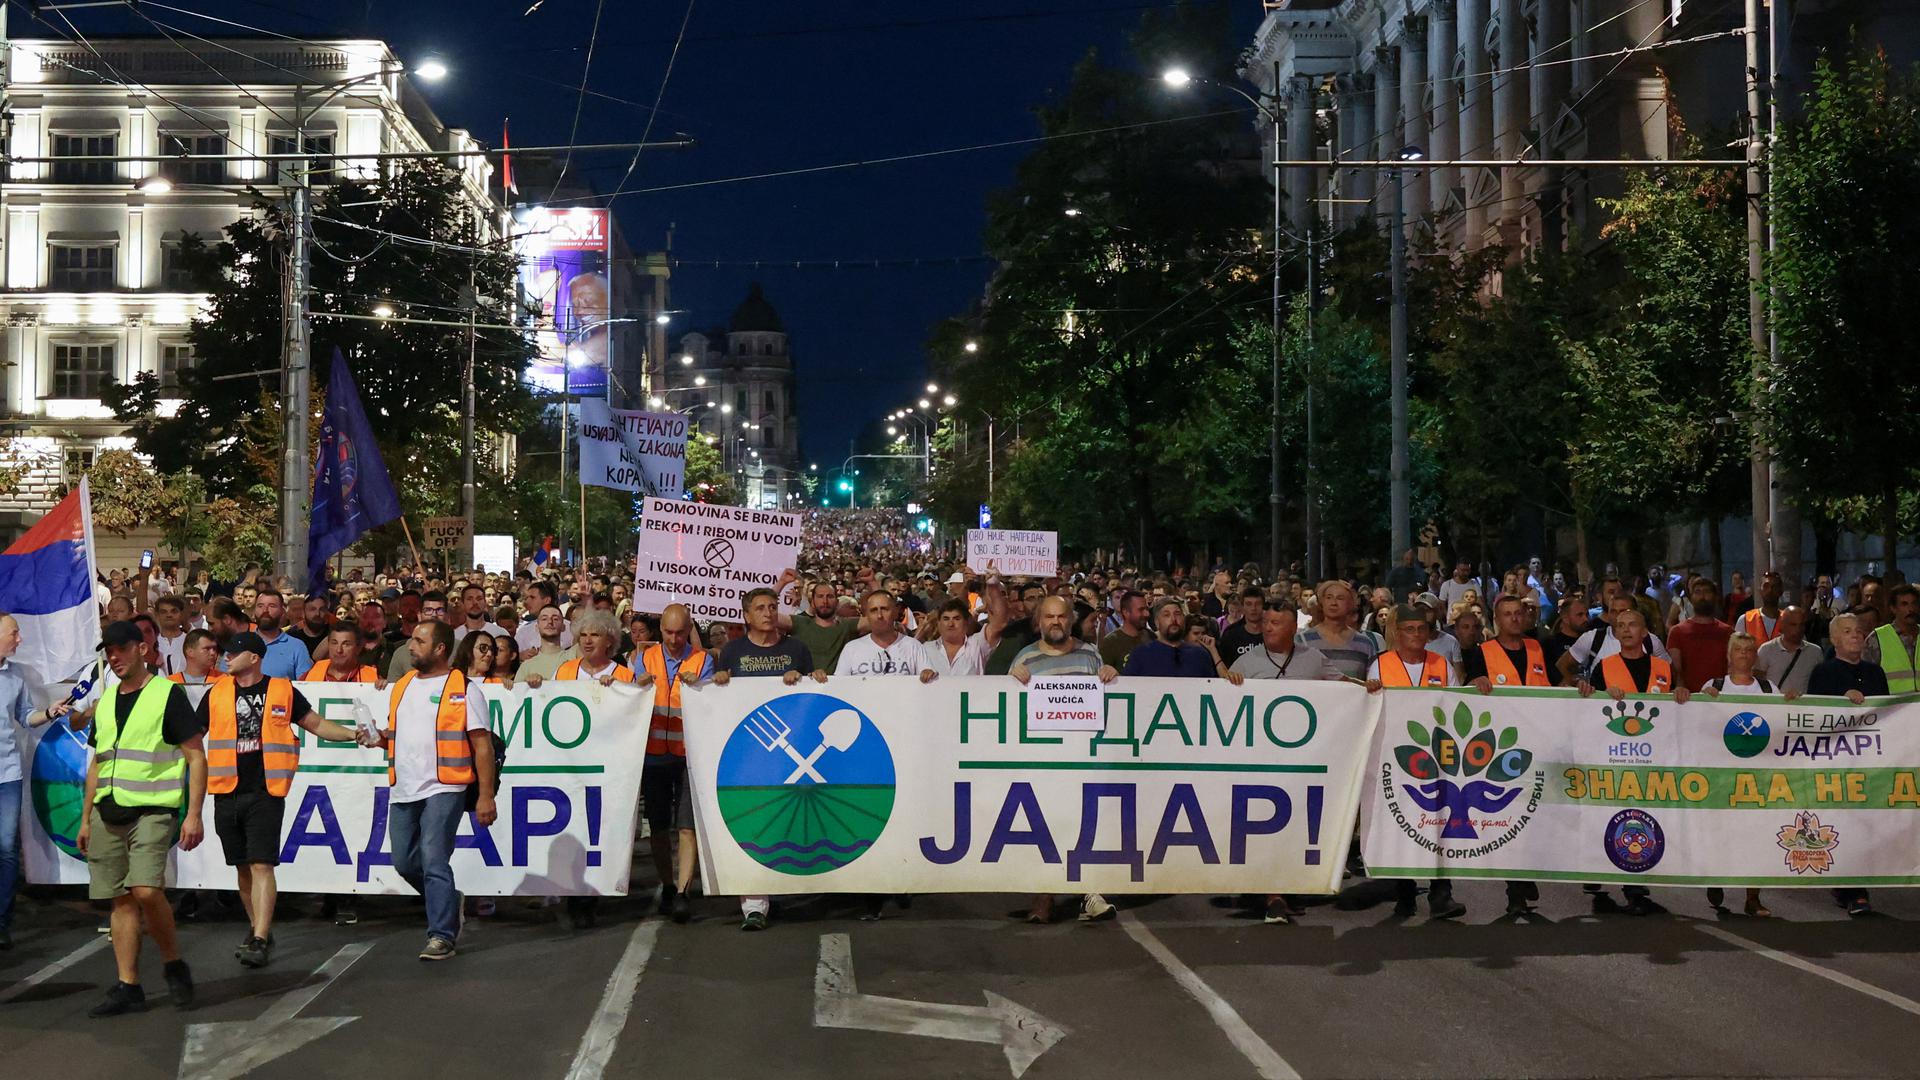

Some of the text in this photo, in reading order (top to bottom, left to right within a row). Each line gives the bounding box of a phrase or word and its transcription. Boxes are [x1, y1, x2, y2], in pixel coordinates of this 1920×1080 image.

[638, 439, 685, 459] ZAKONA
[653, 501, 794, 528] DOMOVINA SE BRANI
[430, 526, 465, 537] FUCK
[645, 519, 693, 535] REKOM
[703, 526, 748, 541] RIBOM
[751, 532, 760, 542] U
[968, 531, 1045, 543] ОВО НИЈЕ НАПРЕДАК
[435, 536, 460, 547] OFF
[974, 544, 988, 555] ОВО
[991, 544, 1000, 555] ЈЕ
[649, 561, 654, 571] I
[656, 561, 721, 580] VISOKOM
[1008, 558, 1026, 572] РИО
[1028, 558, 1055, 573] ТИНТО
[638, 580, 705, 597] SMREKOM
[708, 584, 735, 599] ŠTO
[745, 662, 785, 672] GROWTH
[749, 655, 782, 664] SMART
[1034, 682, 1098, 690] ALEKSANDRA
[1048, 695, 1084, 704] VUČIĆA
[1036, 711, 1097, 720] U ZATVOR!
[1090, 692, 1318, 757] ДАМО
[1787, 712, 1878, 731] НЕ ДАМО
[1774, 734, 1882, 760] ЈАДАР!
[1564, 767, 1710, 801] ЗНАМО
[1729, 772, 1795, 807] ДА
[1815, 772, 1867, 803] НЕ
[1381, 762, 1395, 800] САВЕЗ
[1446, 815, 1531, 859] ОРГАНИЗАЦИЈА
[1526, 770, 1545, 813] СРБИЈЕ
[918, 781, 1324, 883] ЈАДАР!
